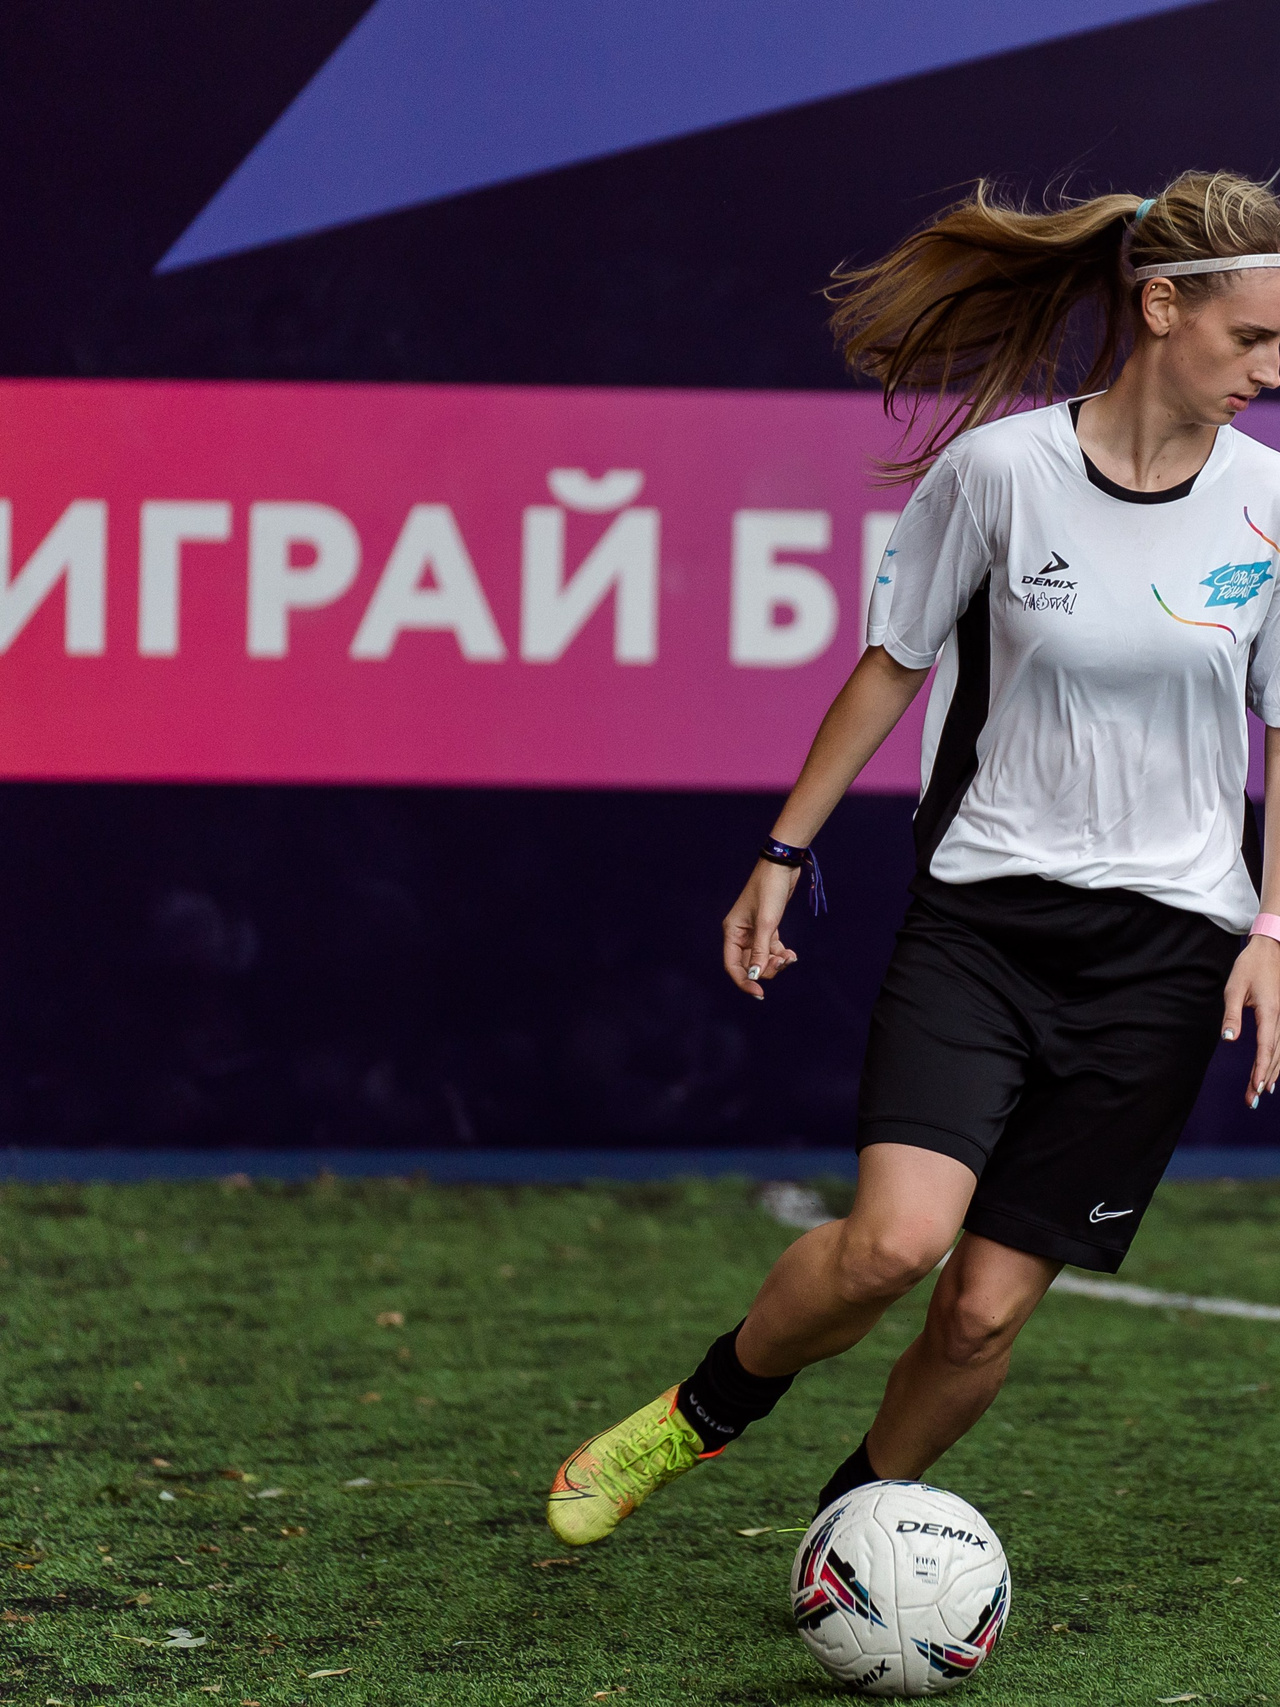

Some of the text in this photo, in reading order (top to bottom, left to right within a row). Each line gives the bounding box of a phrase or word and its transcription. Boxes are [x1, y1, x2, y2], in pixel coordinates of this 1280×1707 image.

[1021, 575, 1079, 590] DEMIX
[895, 1520, 989, 1552] DEMIX
[855, 1657, 892, 1688] MIX
